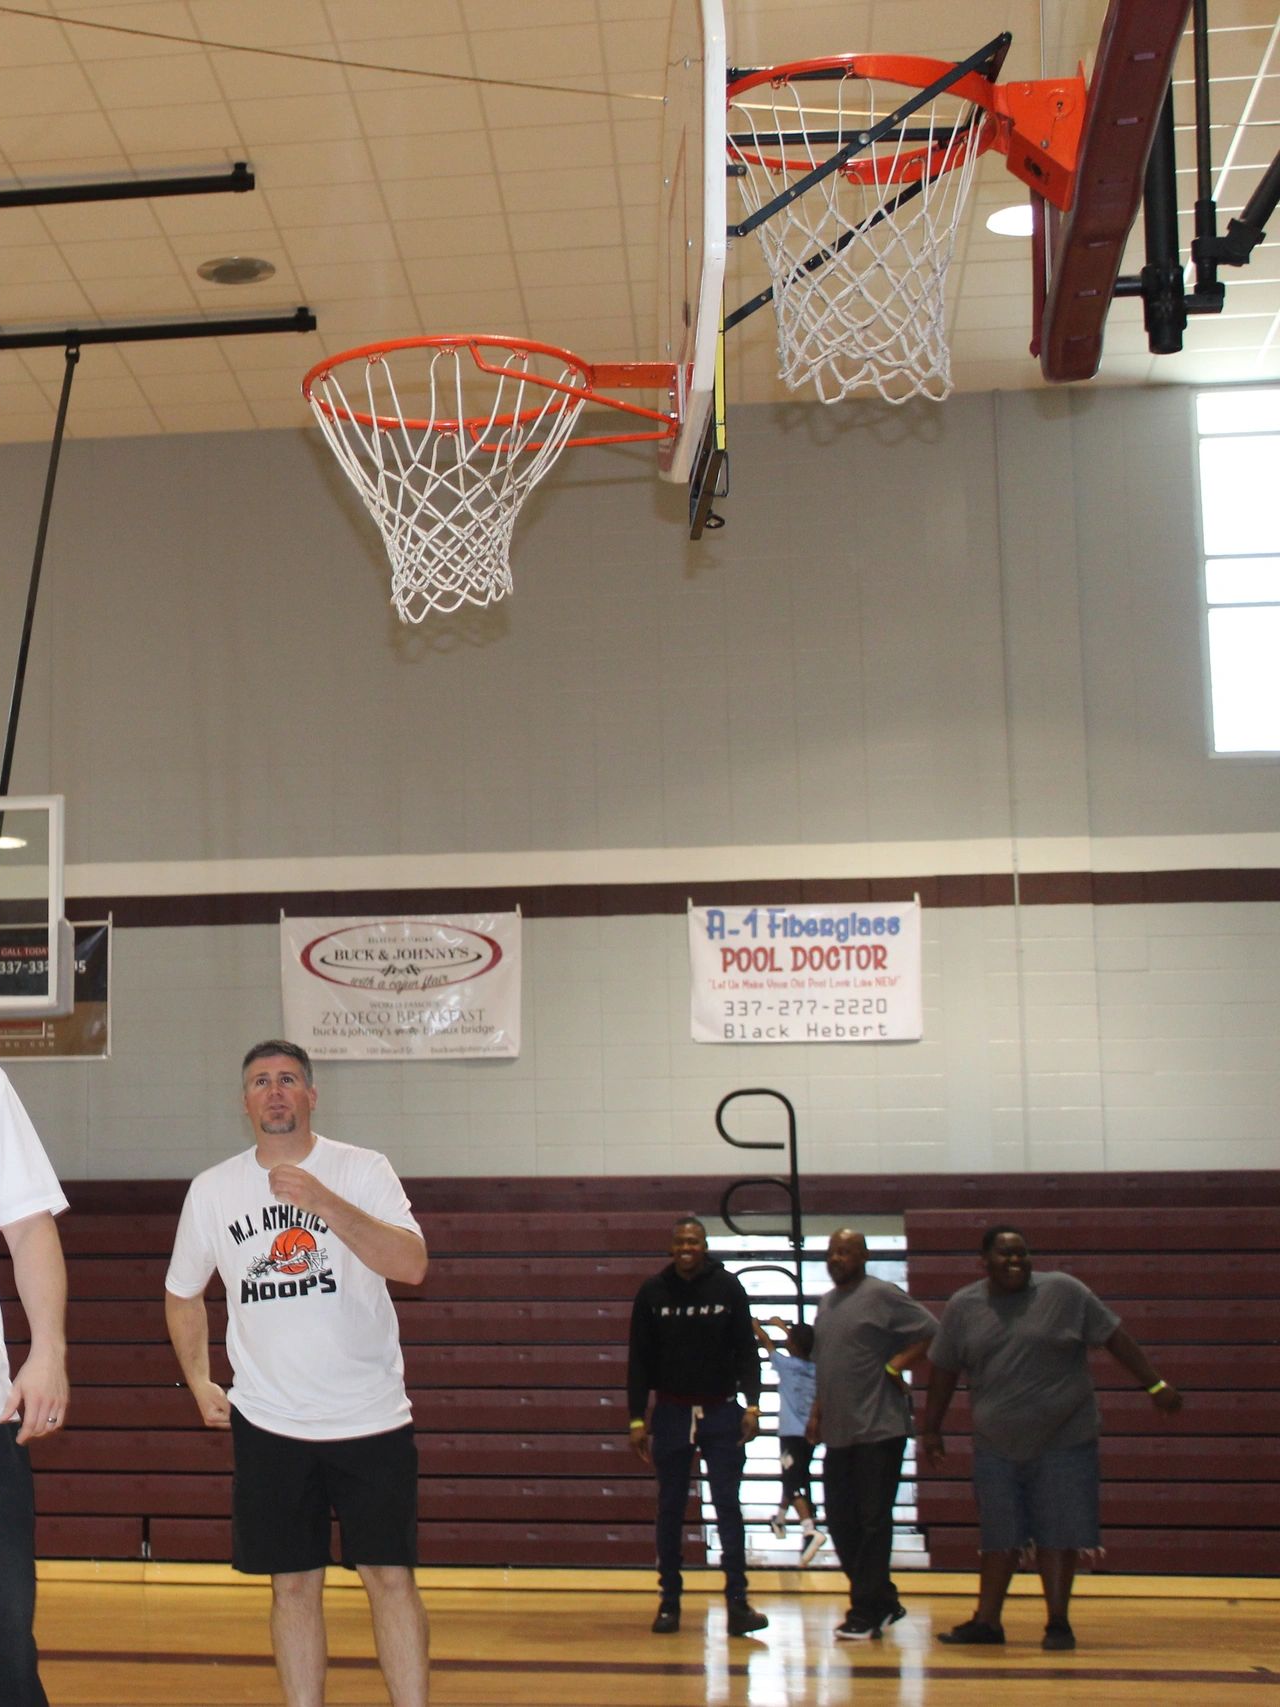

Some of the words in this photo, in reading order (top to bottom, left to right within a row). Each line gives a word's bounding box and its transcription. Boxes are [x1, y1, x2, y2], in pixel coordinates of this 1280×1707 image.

[706, 908, 758, 940] A-1
[767, 908, 901, 943] Fiberglass
[0, 946, 20, 957] CALL
[334, 949, 374, 961] BUCK
[378, 950, 389, 961] &
[393, 947, 470, 960] JOHNNY'S
[720, 946, 783, 973] POOL
[790, 944, 887, 971] DOCTOR
[350, 976, 375, 988] with
[389, 979, 419, 994] cajun
[724, 998, 888, 1016] 337-277-2220
[321, 1010, 391, 1025] ZYDECO
[461, 1024, 496, 1036] bridge
[724, 1023, 790, 1039] Black
[807, 1022, 888, 1038] Hebert
[228, 1214, 258, 1245] M.J.
[241, 1268, 337, 1304] HOOPS
